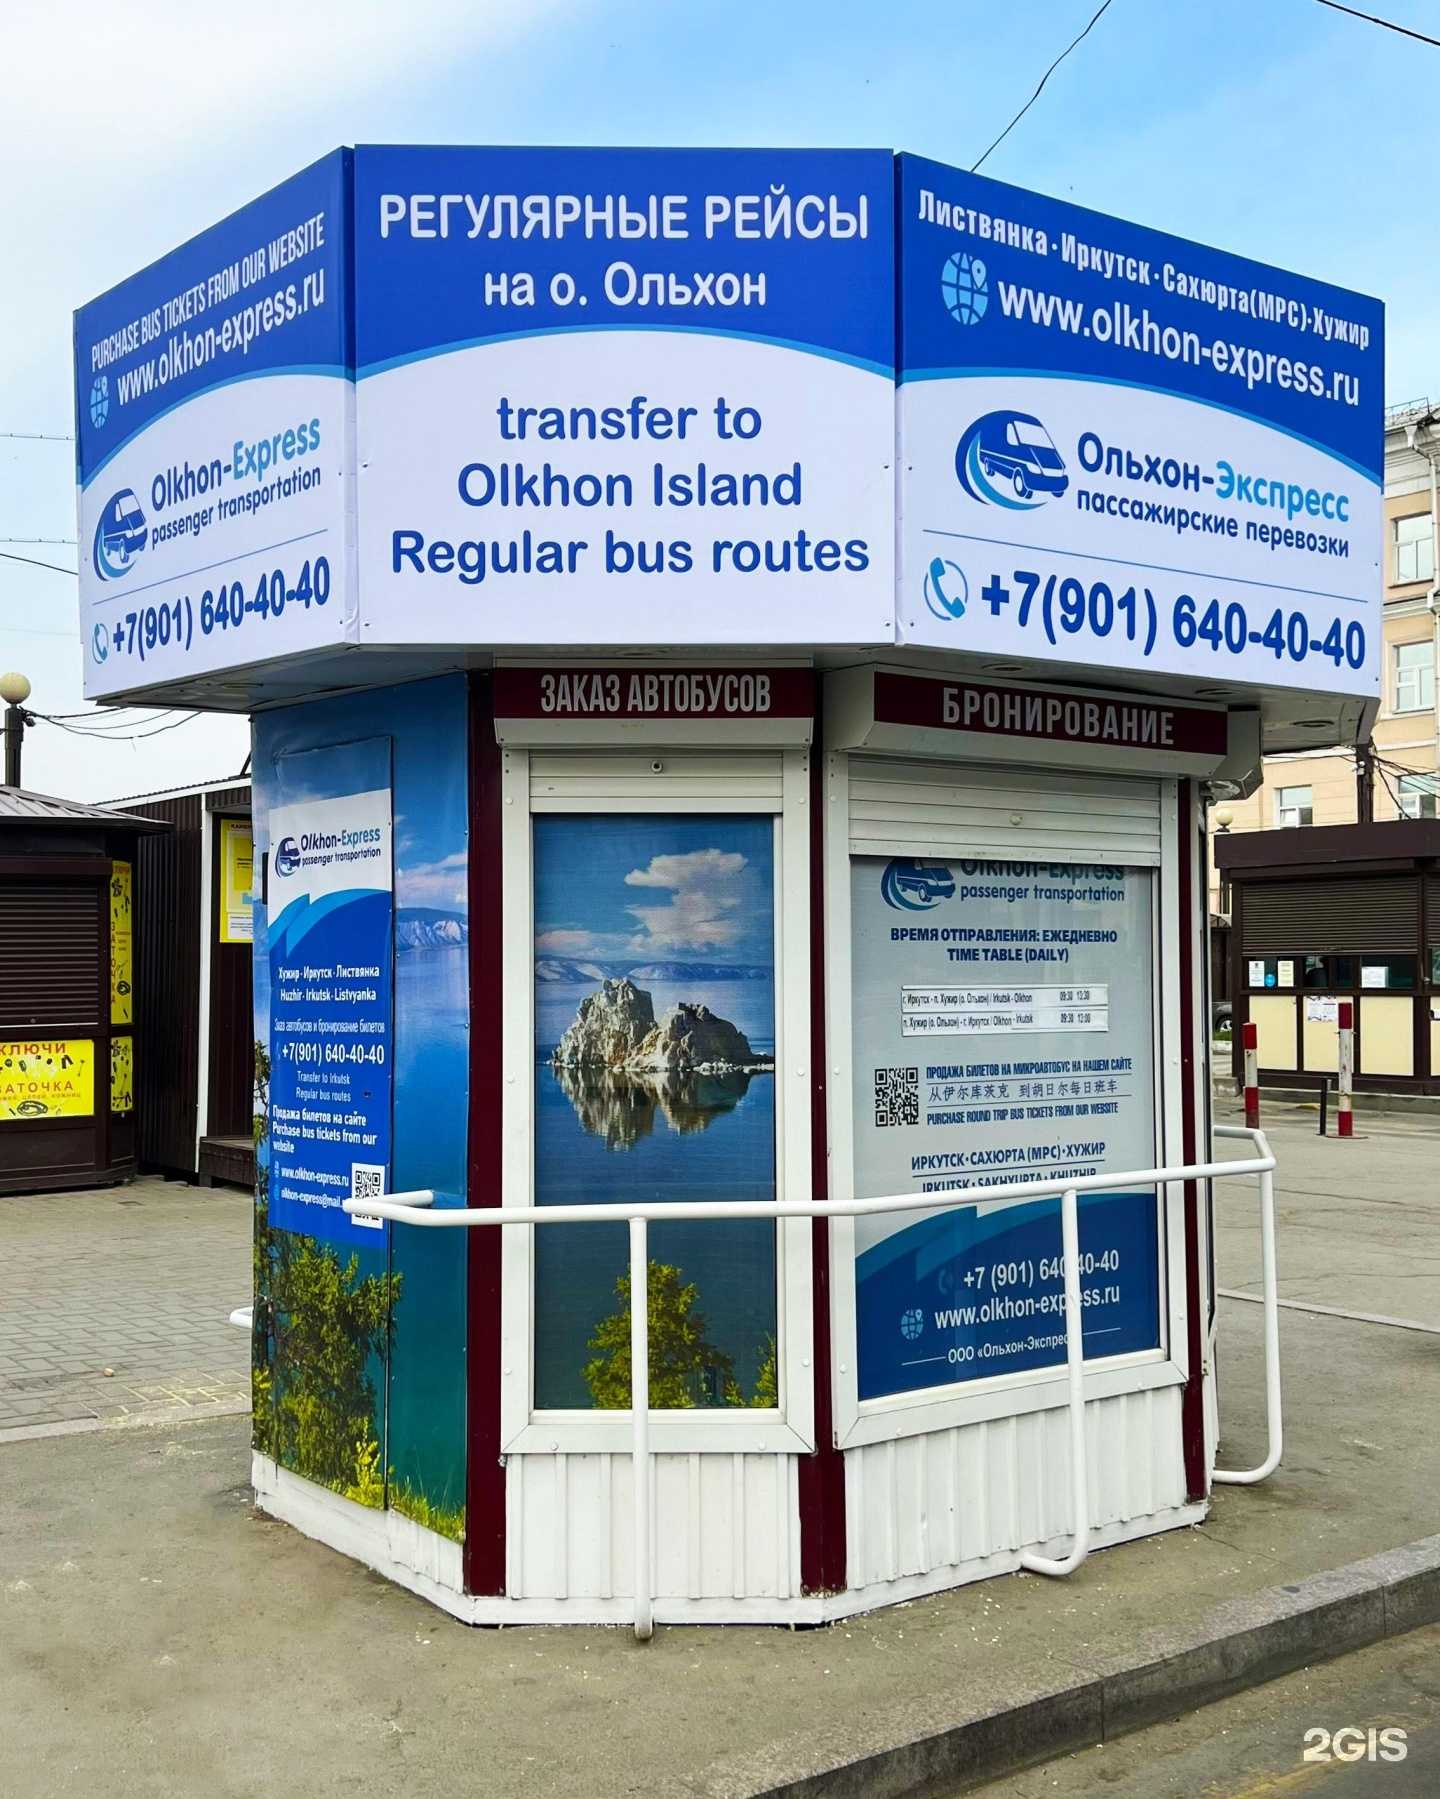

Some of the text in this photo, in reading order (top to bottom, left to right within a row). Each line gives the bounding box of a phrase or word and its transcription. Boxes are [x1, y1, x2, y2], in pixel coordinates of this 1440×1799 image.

[380, 183, 869, 240] РЕГУЛЯРНЫЕ РЕЙСЫ
[919, 189, 1048, 257] Листвянка
[1062, 232, 1150, 286] Иркутск
[92, 212, 324, 372] PURCHASE BUS TICKETS FROM OUR WEBSITE
[485, 261, 766, 306] на о. Ольхон
[117, 268, 324, 406] www.olkhon-express.ru
[998, 281, 1359, 406] www.olkhon-express.ru
[497, 395, 762, 440] transfer to
[151, 418, 321, 512] Olkhon-Express
[458, 462, 802, 507] Olkhon Island
[1078, 432, 1349, 522] Ольхон-Экспресс
[152, 466, 321, 550] passenger transportation
[1077, 489, 1349, 558] пассажирские перевозки
[392, 529, 870, 585] Regular bus routes
[113, 556, 330, 662] +7(901) 640-40-40
[981, 570, 1366, 670] +7(901) 640-40-40
[541, 674, 771, 712] ЗАКАЗ АВТОБУСОВ
[943, 687, 1174, 746] БРОНИРОВАНИЕ
[300, 828, 381, 852] Olkhon-Express
[302, 847, 381, 867] passenger transportation
[961, 885, 1125, 904] passenger transportation
[890, 928, 1118, 945] ВРЕМЯ ОТПРАВЛЕНИЯ: ЕЖЕДНЕВНО
[947, 947, 1069, 963] TIME TABLE (DAILY)
[278, 965, 380, 982] Хужир Иркутск Листвянка
[306, 988, 331, 1001] Irkutsk
[334, 987, 376, 1004] Listvyanka
[282, 1043, 384, 1067] +7(901) 640-40-40
[926, 1057, 1132, 1080] ПРОДАЖА БИЛЕТОВ НА МИКРОАВТОБУС НА НАШЕМ САЙТЕ
[0, 1081, 73, 1093] АТОЧКА
[272, 1105, 367, 1126] Продажа билетов на сайте
[272, 1121, 377, 1145] Purchase bus tickets from our
[927, 1102, 1119, 1126] PURCHASE ROUND TRIP BUS TICKETS FROM OUR WEBSITE
[281, 1167, 349, 1187] www.olkhon-express.ru
[964, 1249, 1119, 1292] +7 (901) 64040-40
[948, 1346, 974, 1364] ООО
